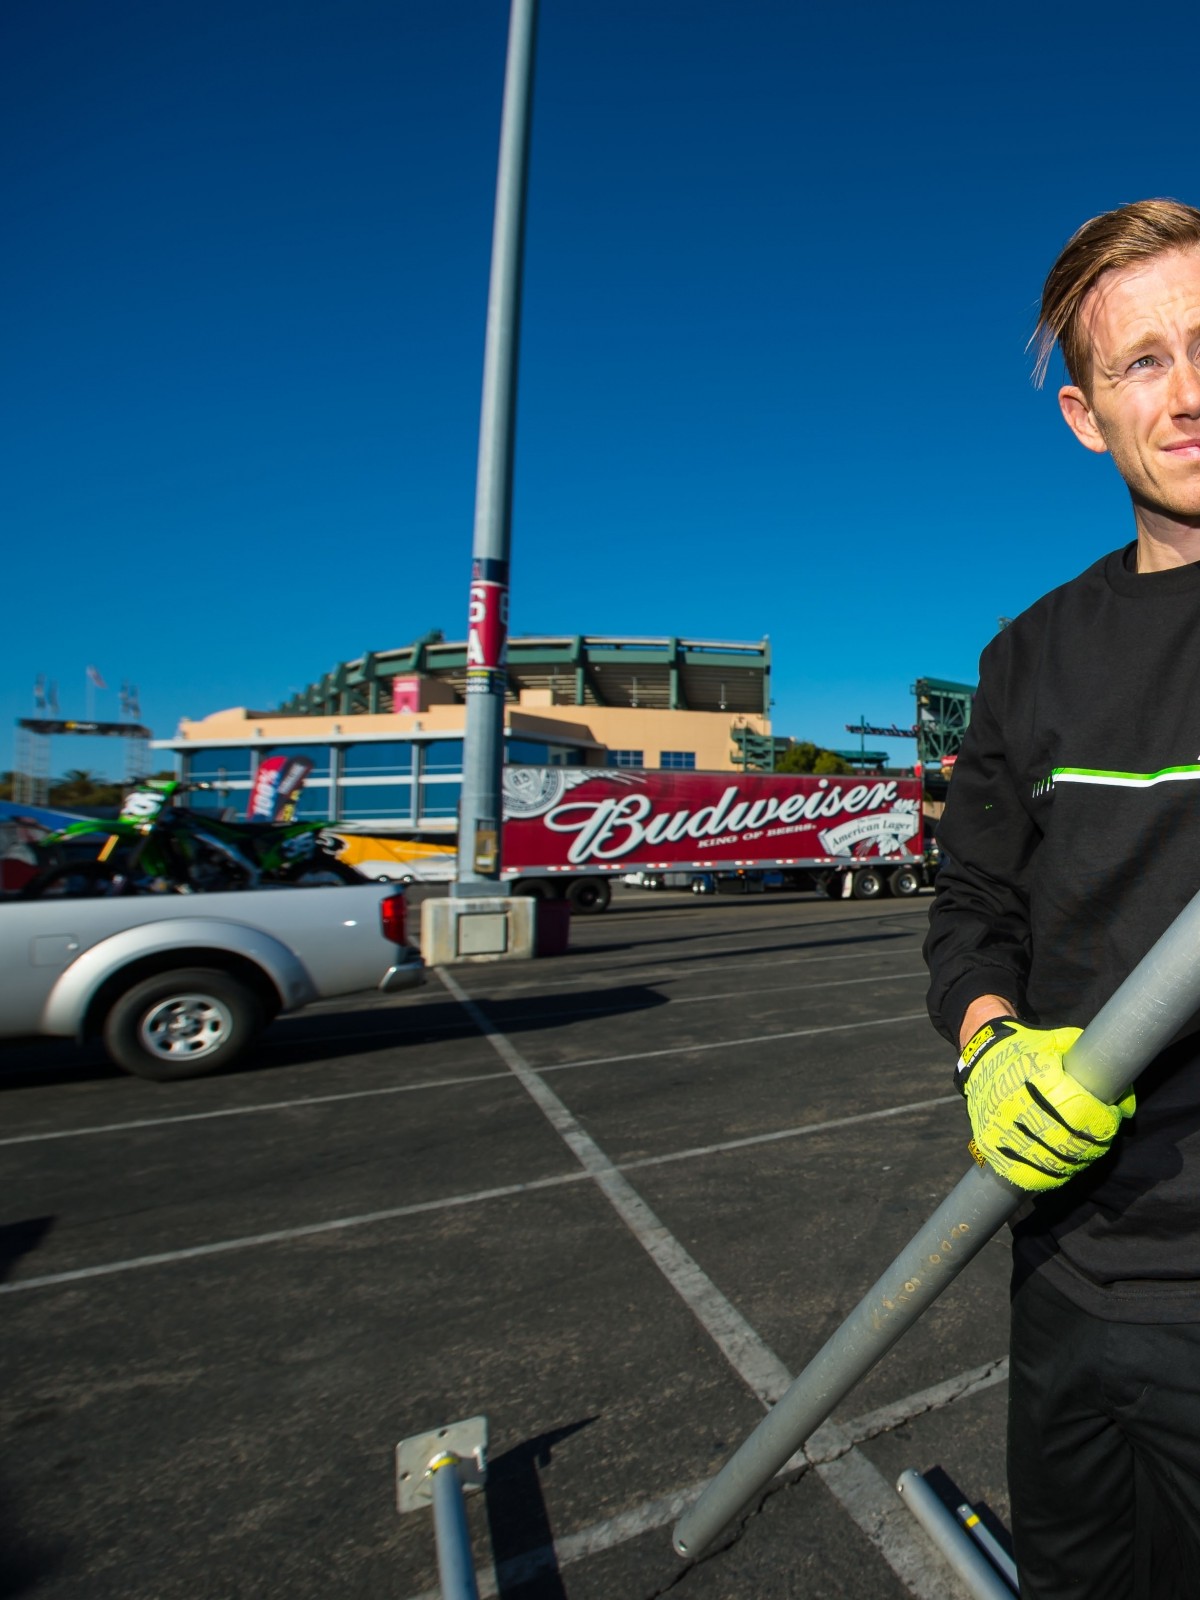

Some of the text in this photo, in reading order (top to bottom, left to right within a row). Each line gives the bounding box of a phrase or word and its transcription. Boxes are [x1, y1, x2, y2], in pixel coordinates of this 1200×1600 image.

[543, 778, 897, 864] Budweiser
[832, 819, 912, 848] American Lager
[697, 835, 738, 849] KING
[742, 831, 763, 841] OF
